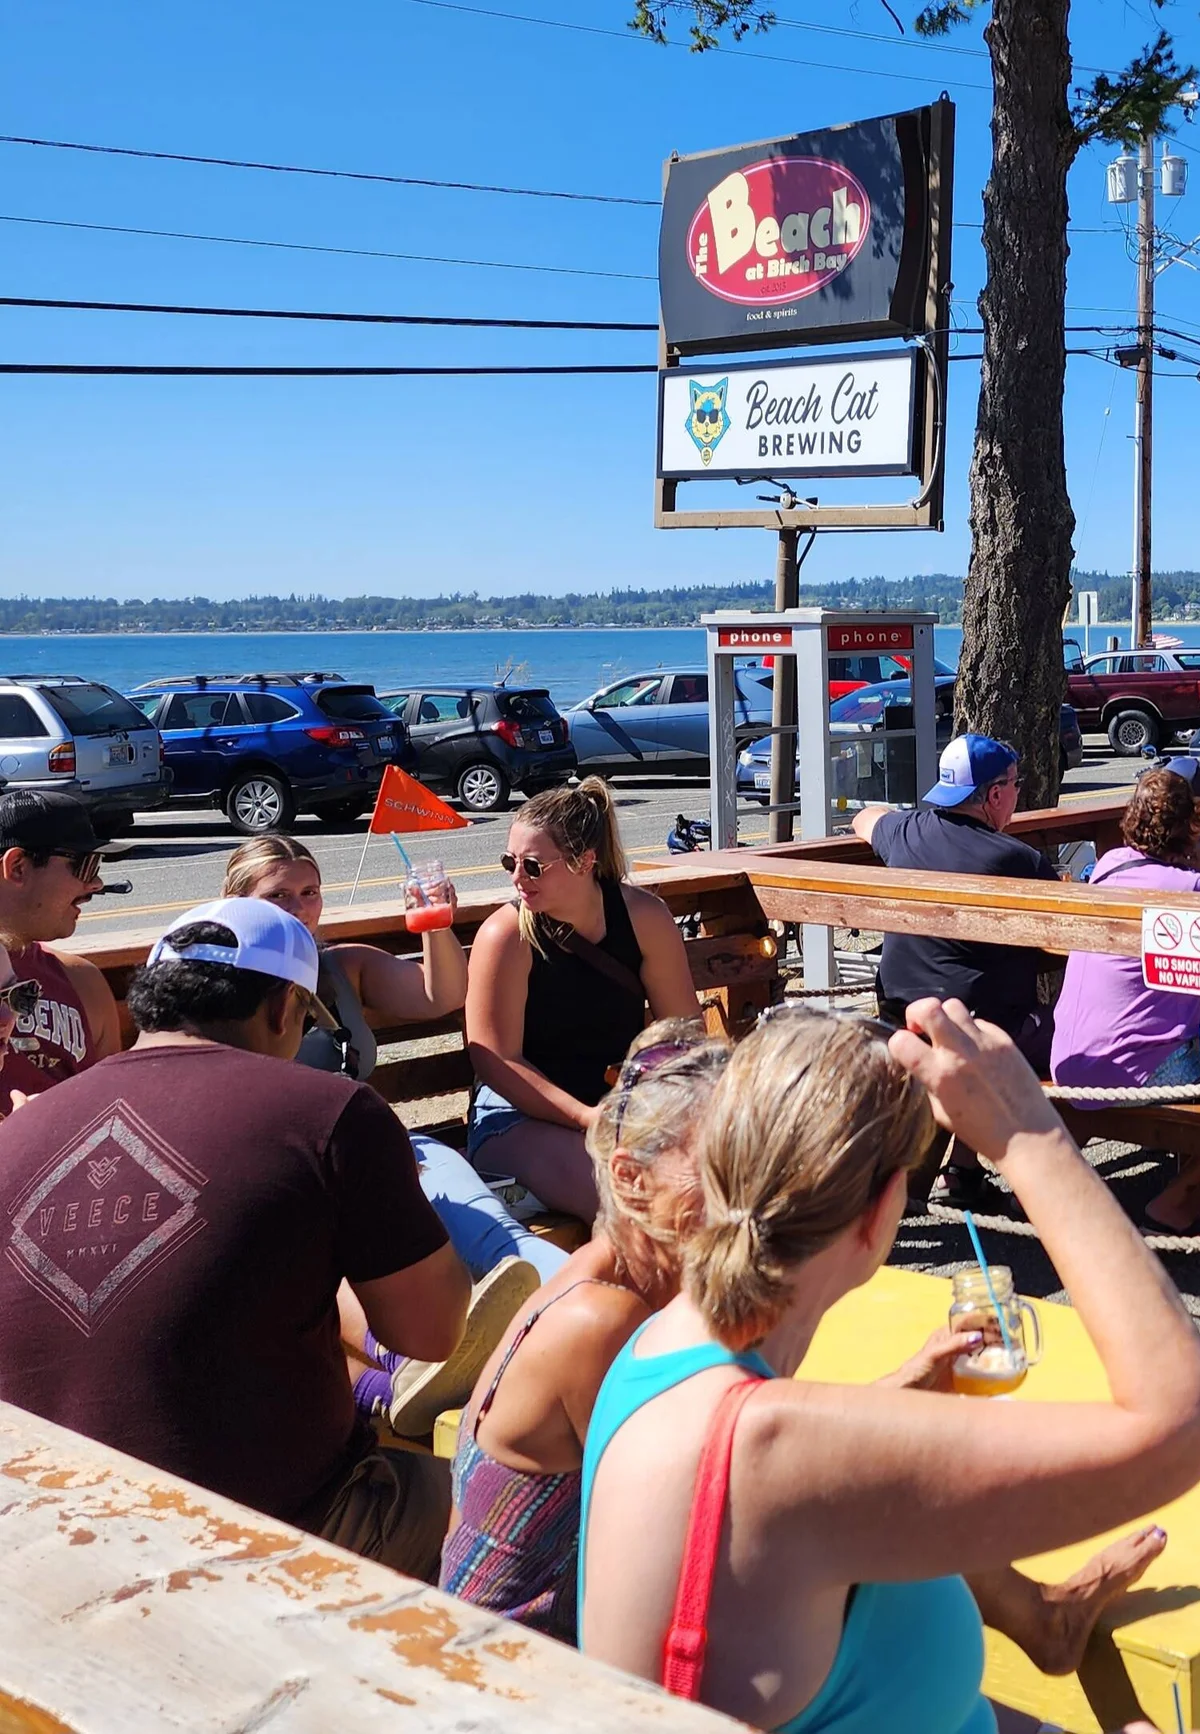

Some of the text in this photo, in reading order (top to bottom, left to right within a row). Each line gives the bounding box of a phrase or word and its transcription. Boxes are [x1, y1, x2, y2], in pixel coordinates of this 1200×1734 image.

[708, 172, 861, 275] Beach
[695, 232, 708, 278] The
[745, 252, 847, 281] at Birch Bay
[746, 307, 798, 321] food & spirits
[746, 372, 879, 430] Beach Cat
[758, 429, 862, 457] BREWING
[730, 630, 782, 644] phone
[841, 630, 899, 645] phone
[384, 798, 455, 825] SCHWINN
[1154, 956, 1169, 970] NO
[1158, 971, 1174, 984] NO
[40, 1192, 160, 1236] VEECE
